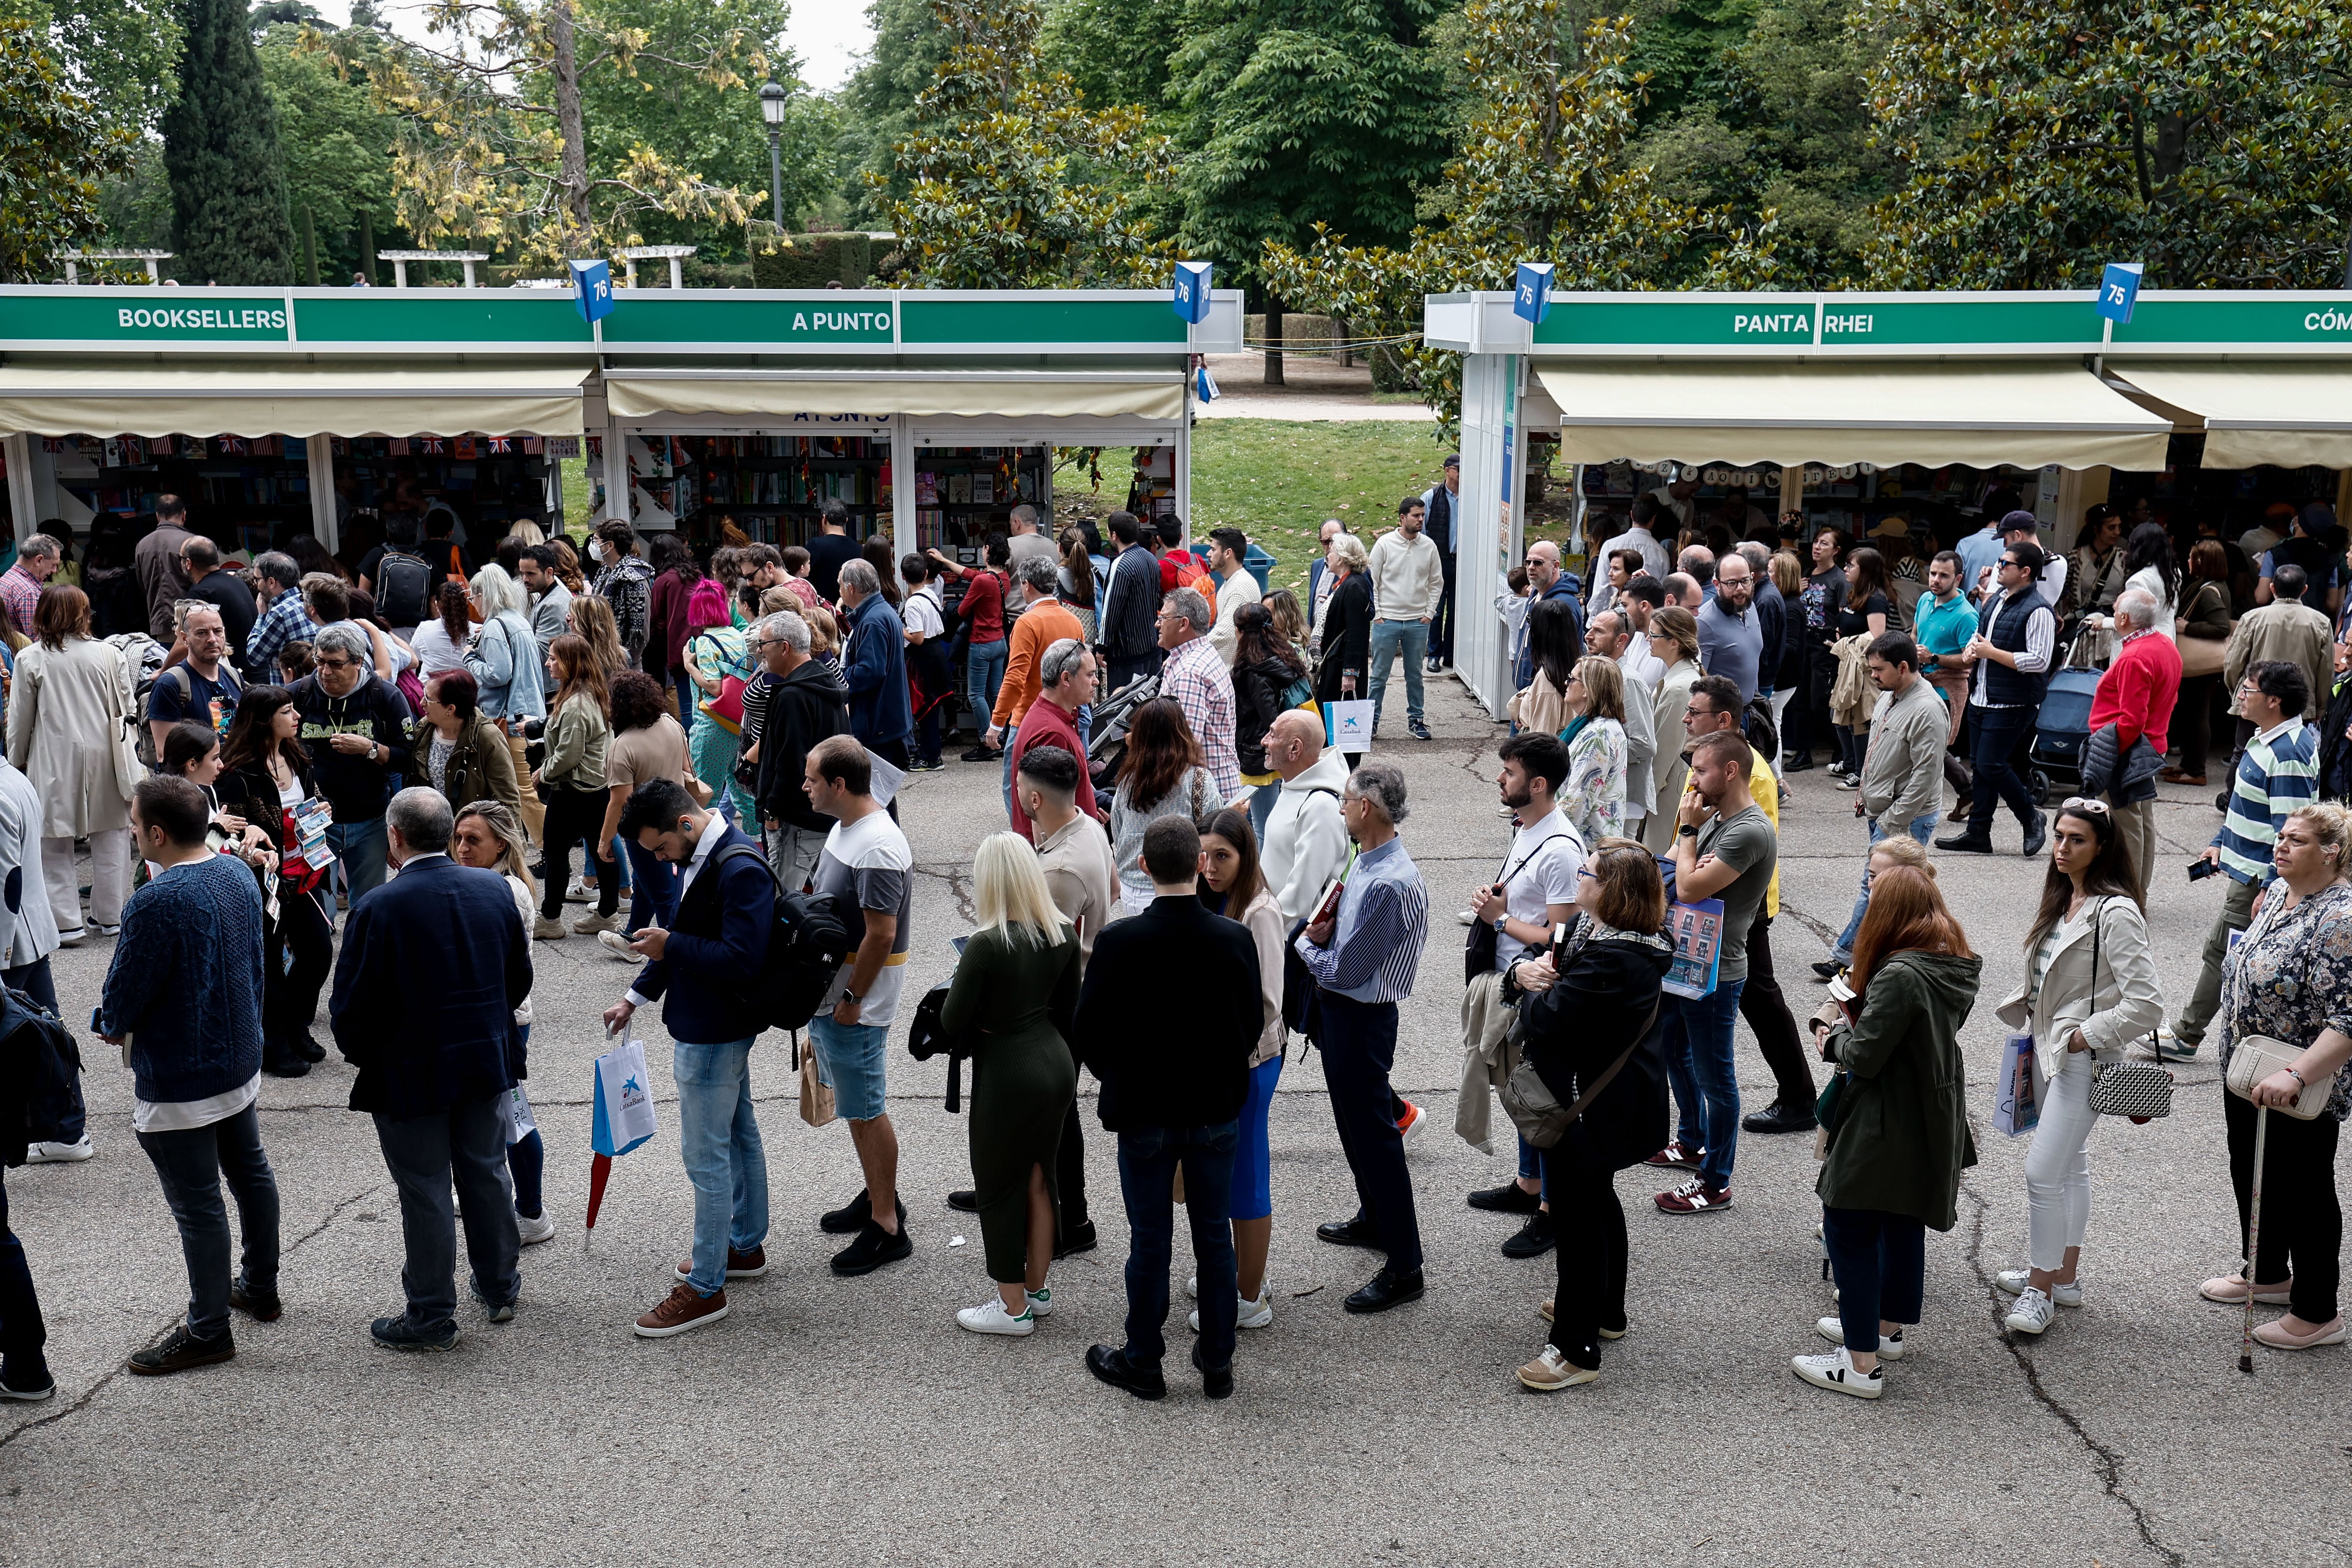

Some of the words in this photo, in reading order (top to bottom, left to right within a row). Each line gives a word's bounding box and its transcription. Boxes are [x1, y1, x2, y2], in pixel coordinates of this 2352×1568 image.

[594, 279, 607, 301] 76
[1178, 281, 1189, 303] 76
[1202, 283, 1209, 303] 76
[1520, 284, 1533, 305] 75
[2107, 284, 2126, 305] 75
[119, 309, 286, 329] BOOKSELLERS
[792, 312, 808, 330] A
[813, 312, 891, 331] PUNTO
[1734, 315, 1809, 333] PANTA
[1825, 315, 1874, 333] RHEI
[517, 1104, 527, 1121] FSC
[619, 1094, 646, 1111] CaixaBank
